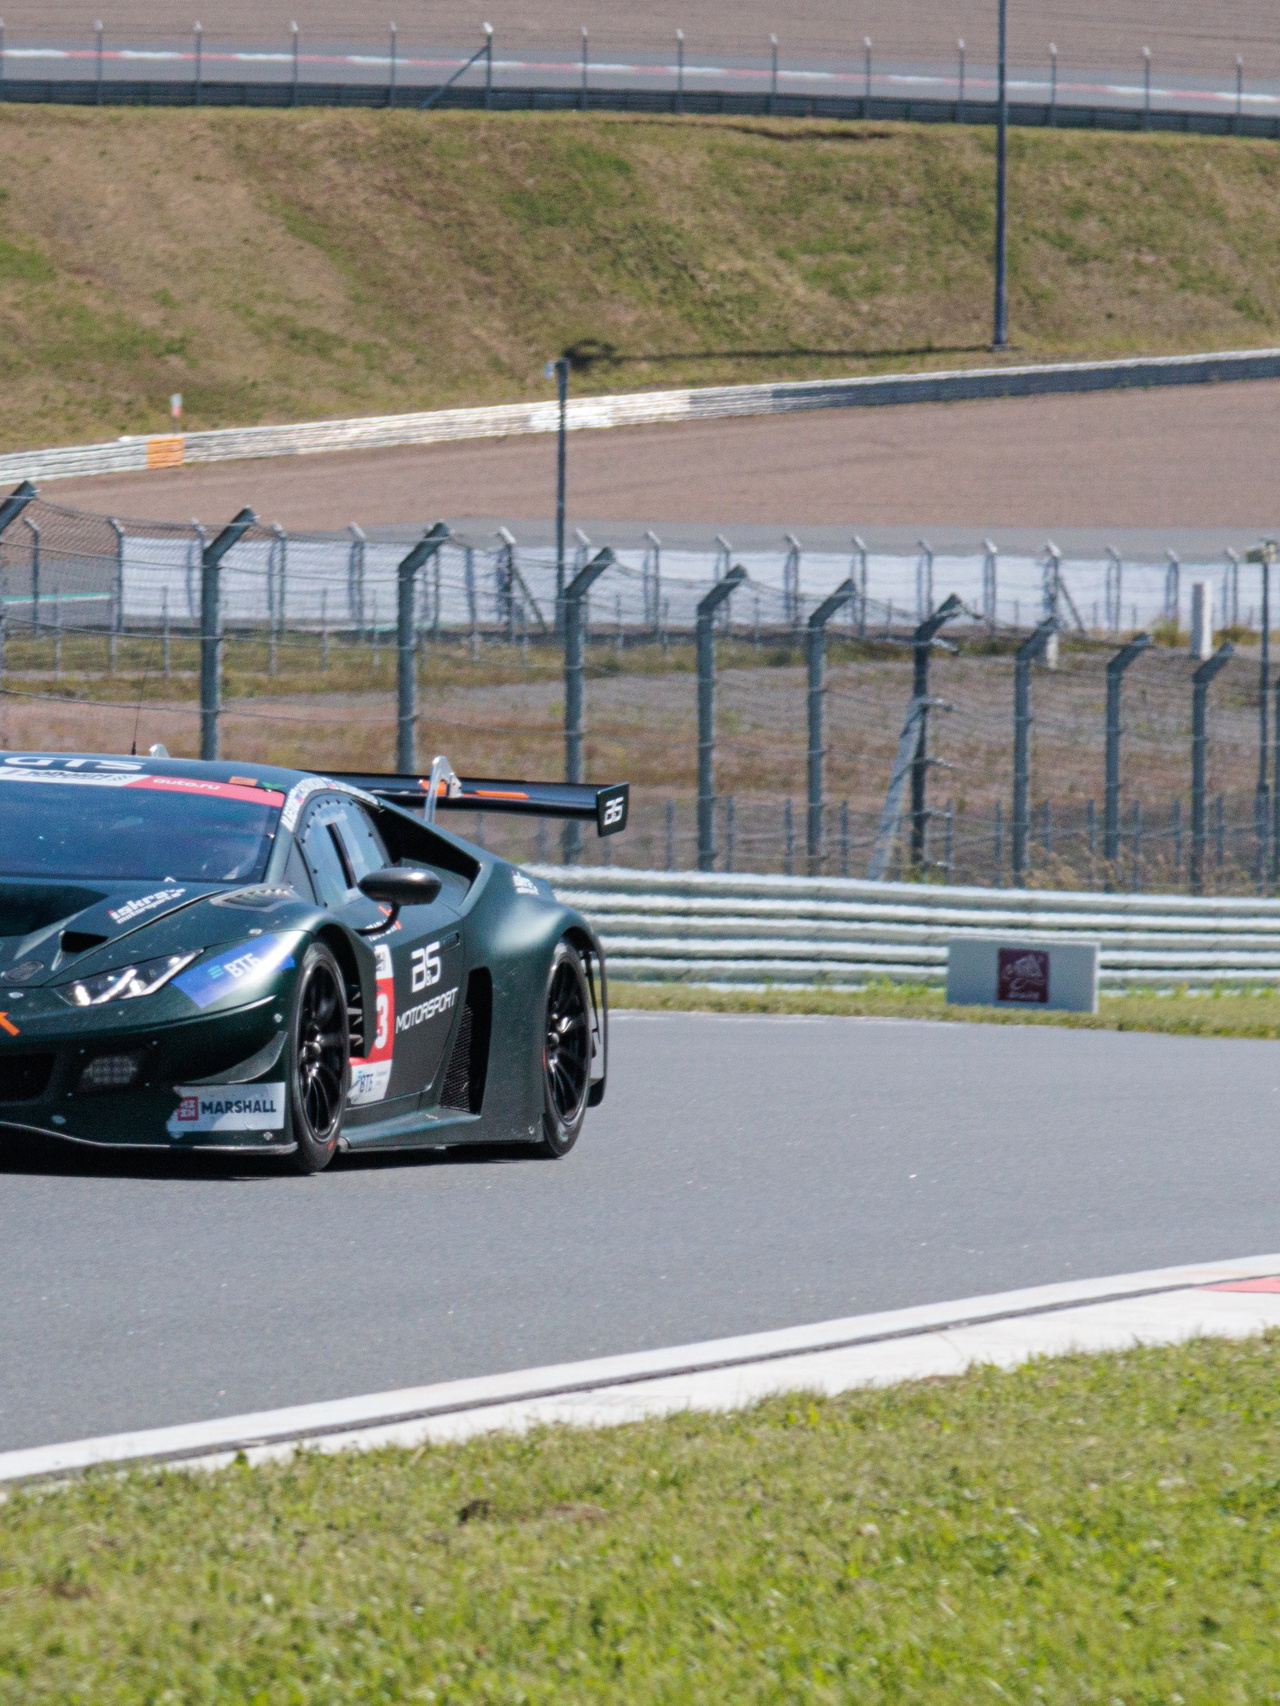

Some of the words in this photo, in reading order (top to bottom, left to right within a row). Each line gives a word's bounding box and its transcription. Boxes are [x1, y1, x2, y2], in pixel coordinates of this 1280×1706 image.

[4, 756, 146, 771] GTS
[153, 778, 221, 790] auto.ru
[395, 986, 459, 1034] MOTORSPORT
[201, 1100, 277, 1115] MARSHALL
